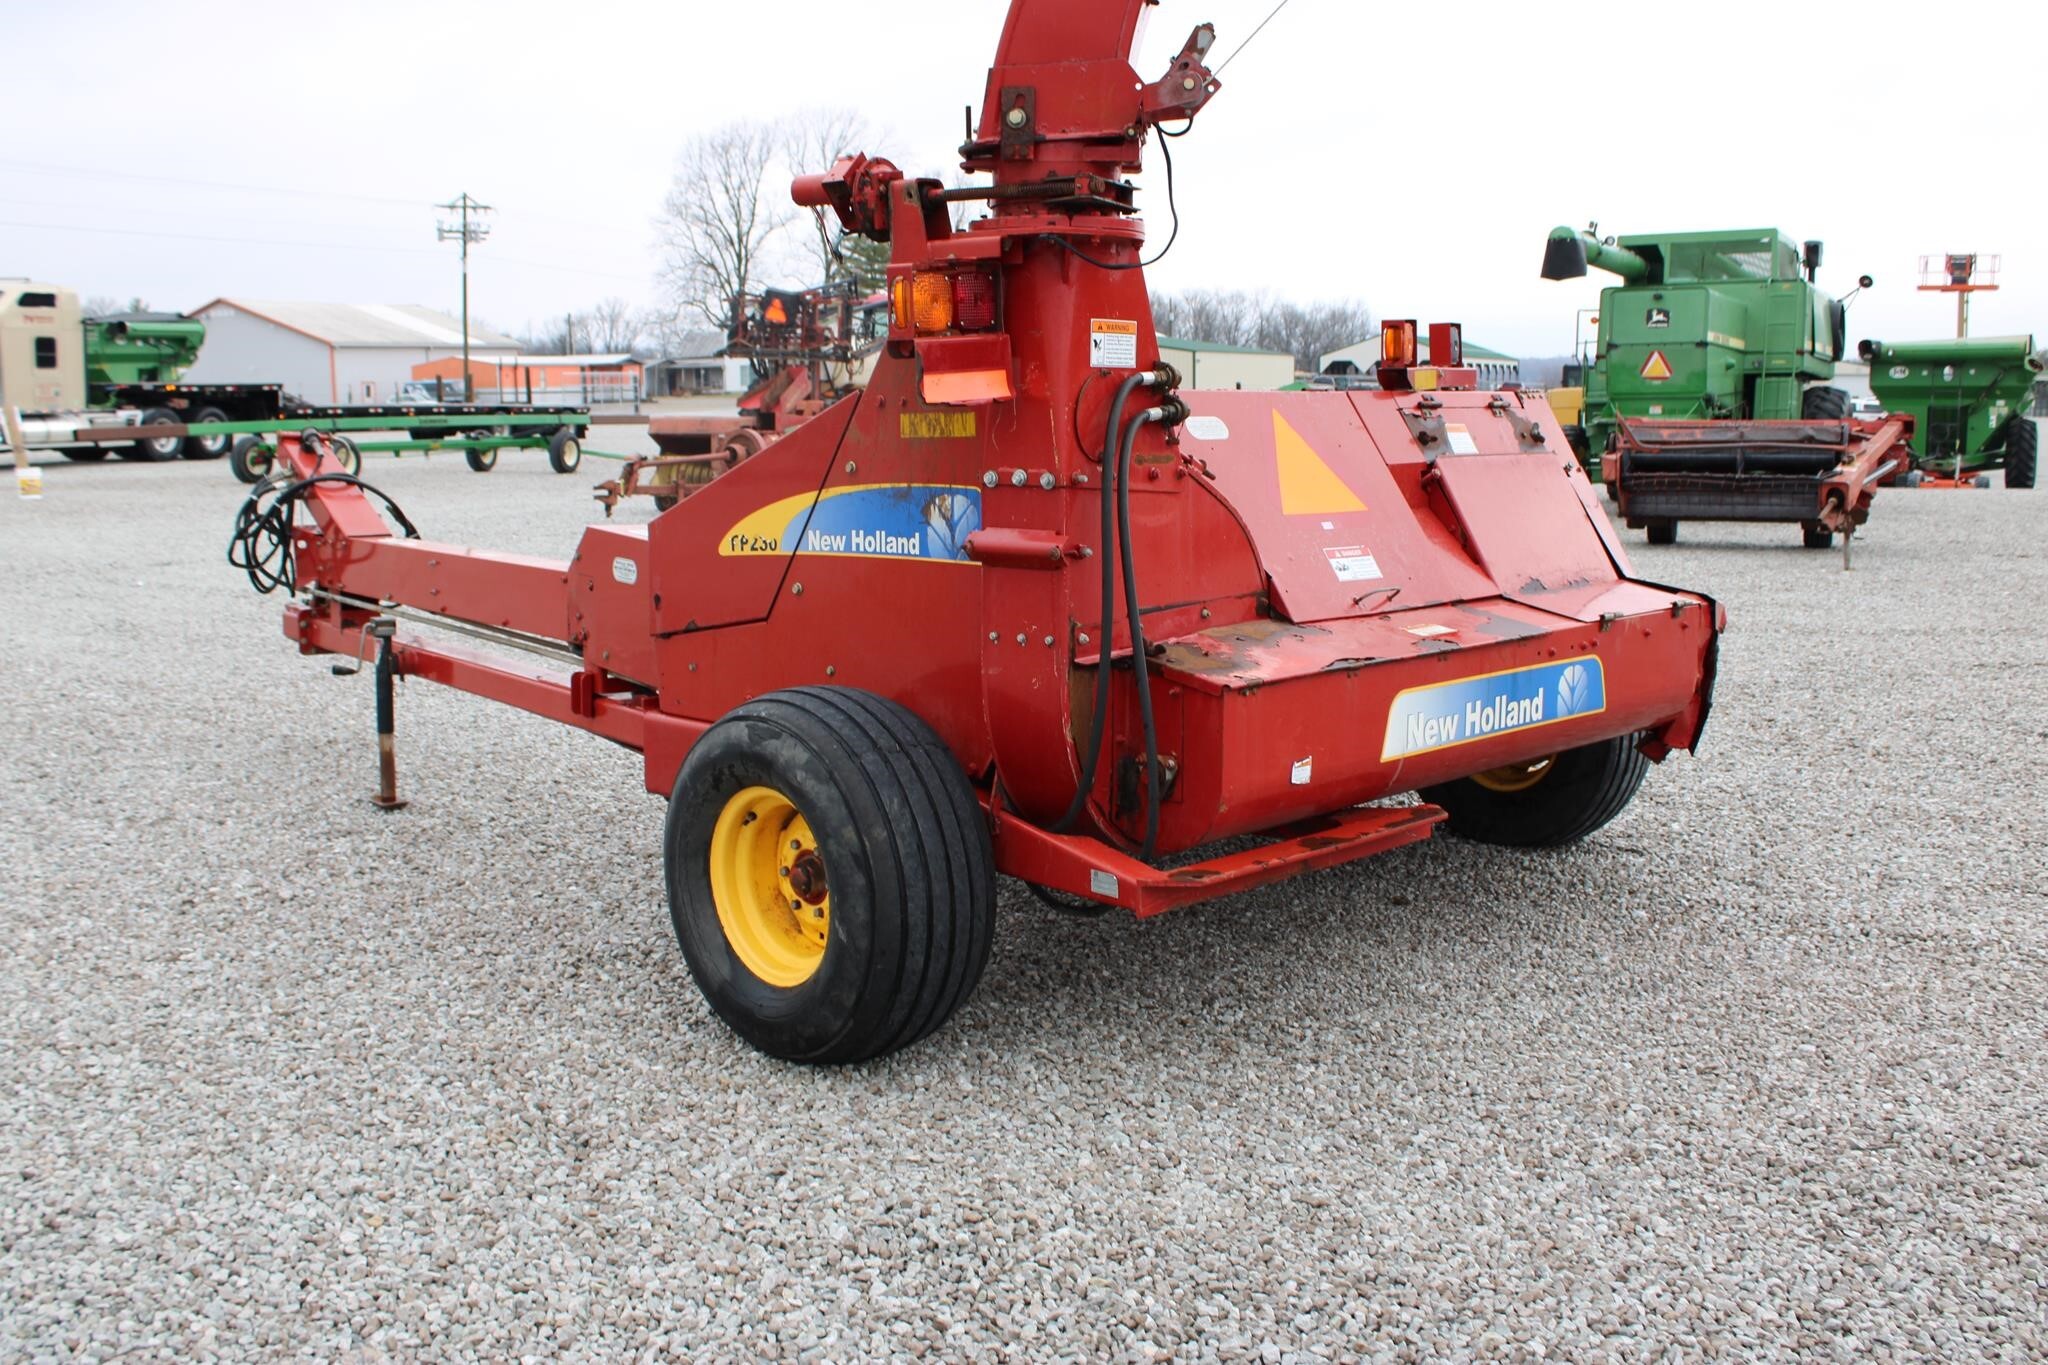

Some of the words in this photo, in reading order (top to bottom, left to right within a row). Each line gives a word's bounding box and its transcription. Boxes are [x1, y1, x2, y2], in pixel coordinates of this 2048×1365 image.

[807, 530, 846, 552] New
[851, 530, 920, 555] Holland
[1406, 711, 1459, 750] New
[1464, 687, 1544, 737] Holland
